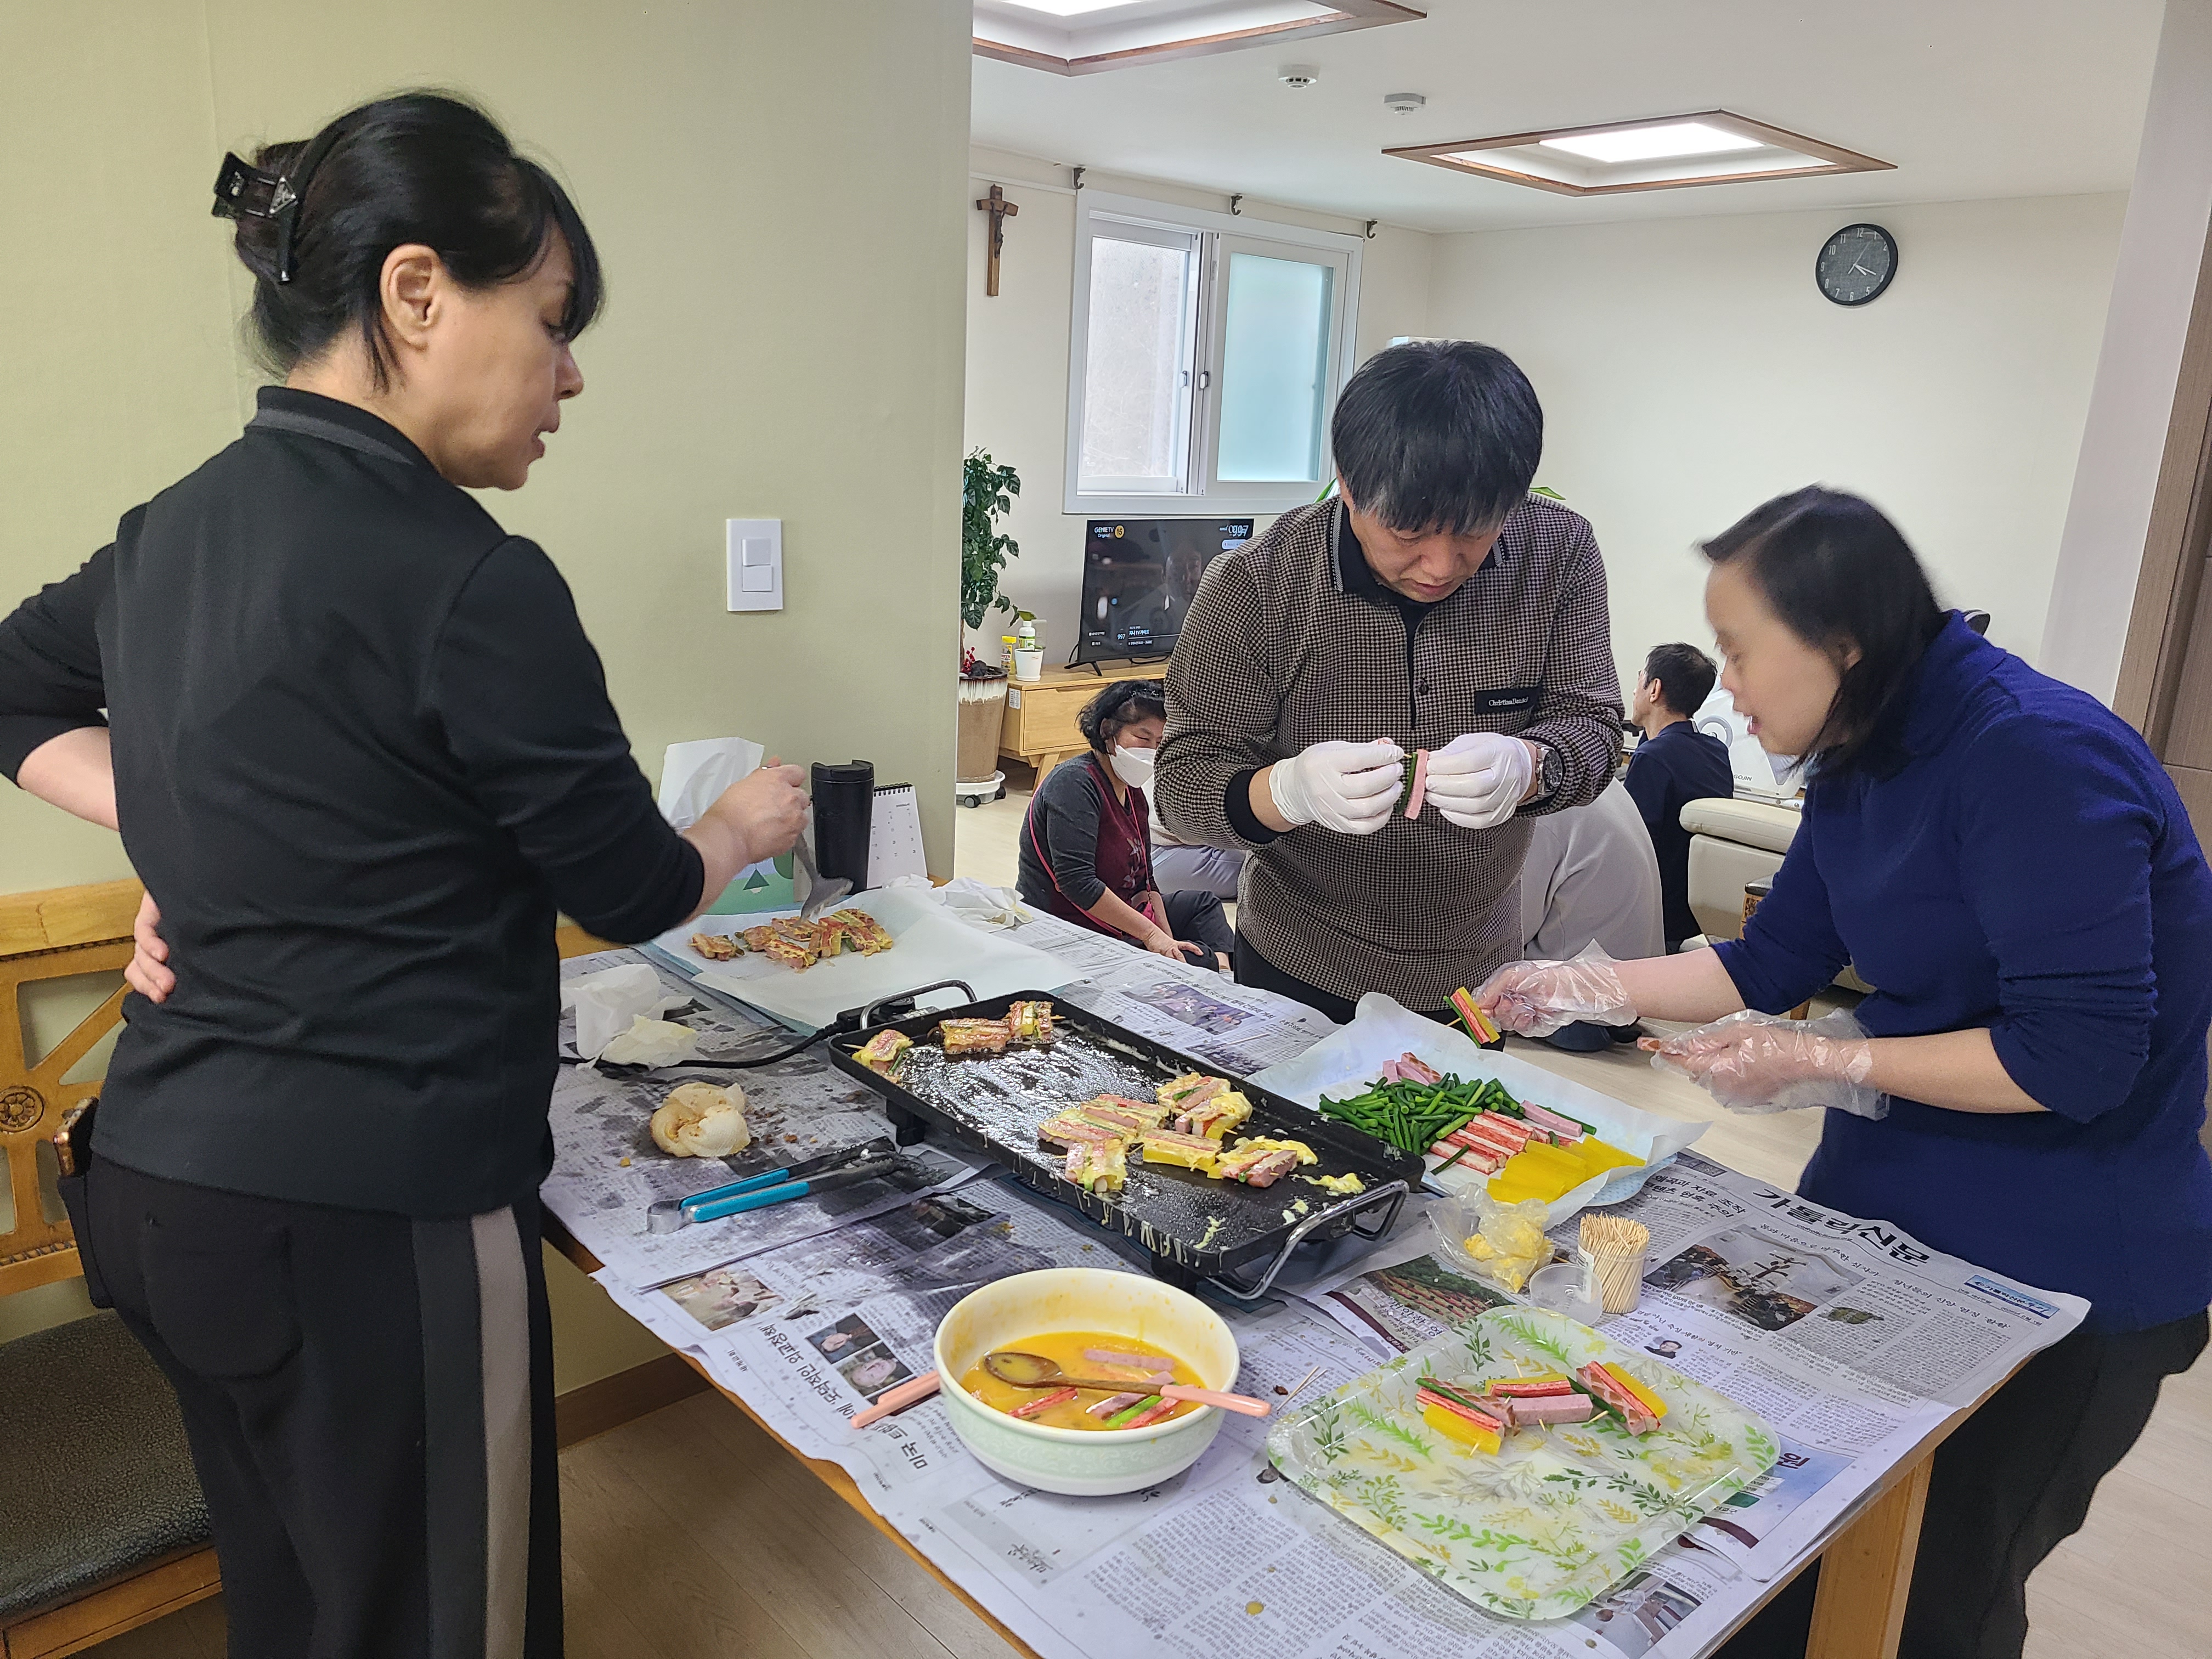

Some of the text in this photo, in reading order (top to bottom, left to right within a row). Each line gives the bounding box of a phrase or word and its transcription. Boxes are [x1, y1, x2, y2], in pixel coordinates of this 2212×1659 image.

[1857, 228, 1864, 237] 12
[1839, 234, 1846, 244] 11
[1829, 245, 1836, 255] 10
[1820, 262, 1825, 272] 9
[1825, 278, 1829, 289] 8
[1835, 288, 1840, 298] 7
[1866, 286, 1870, 296] 5
[1849, 291, 1854, 302] 6
[1654, 1175, 1691, 1187] 왜곡과
[1691, 1184, 1718, 1198] 자료
[1718, 1198, 1746, 1214] 조작
[1708, 1202, 1735, 1218] 주의
[1752, 1188, 1930, 1267] 가톨릭신문
[900, 1441, 929, 1470] 미국
